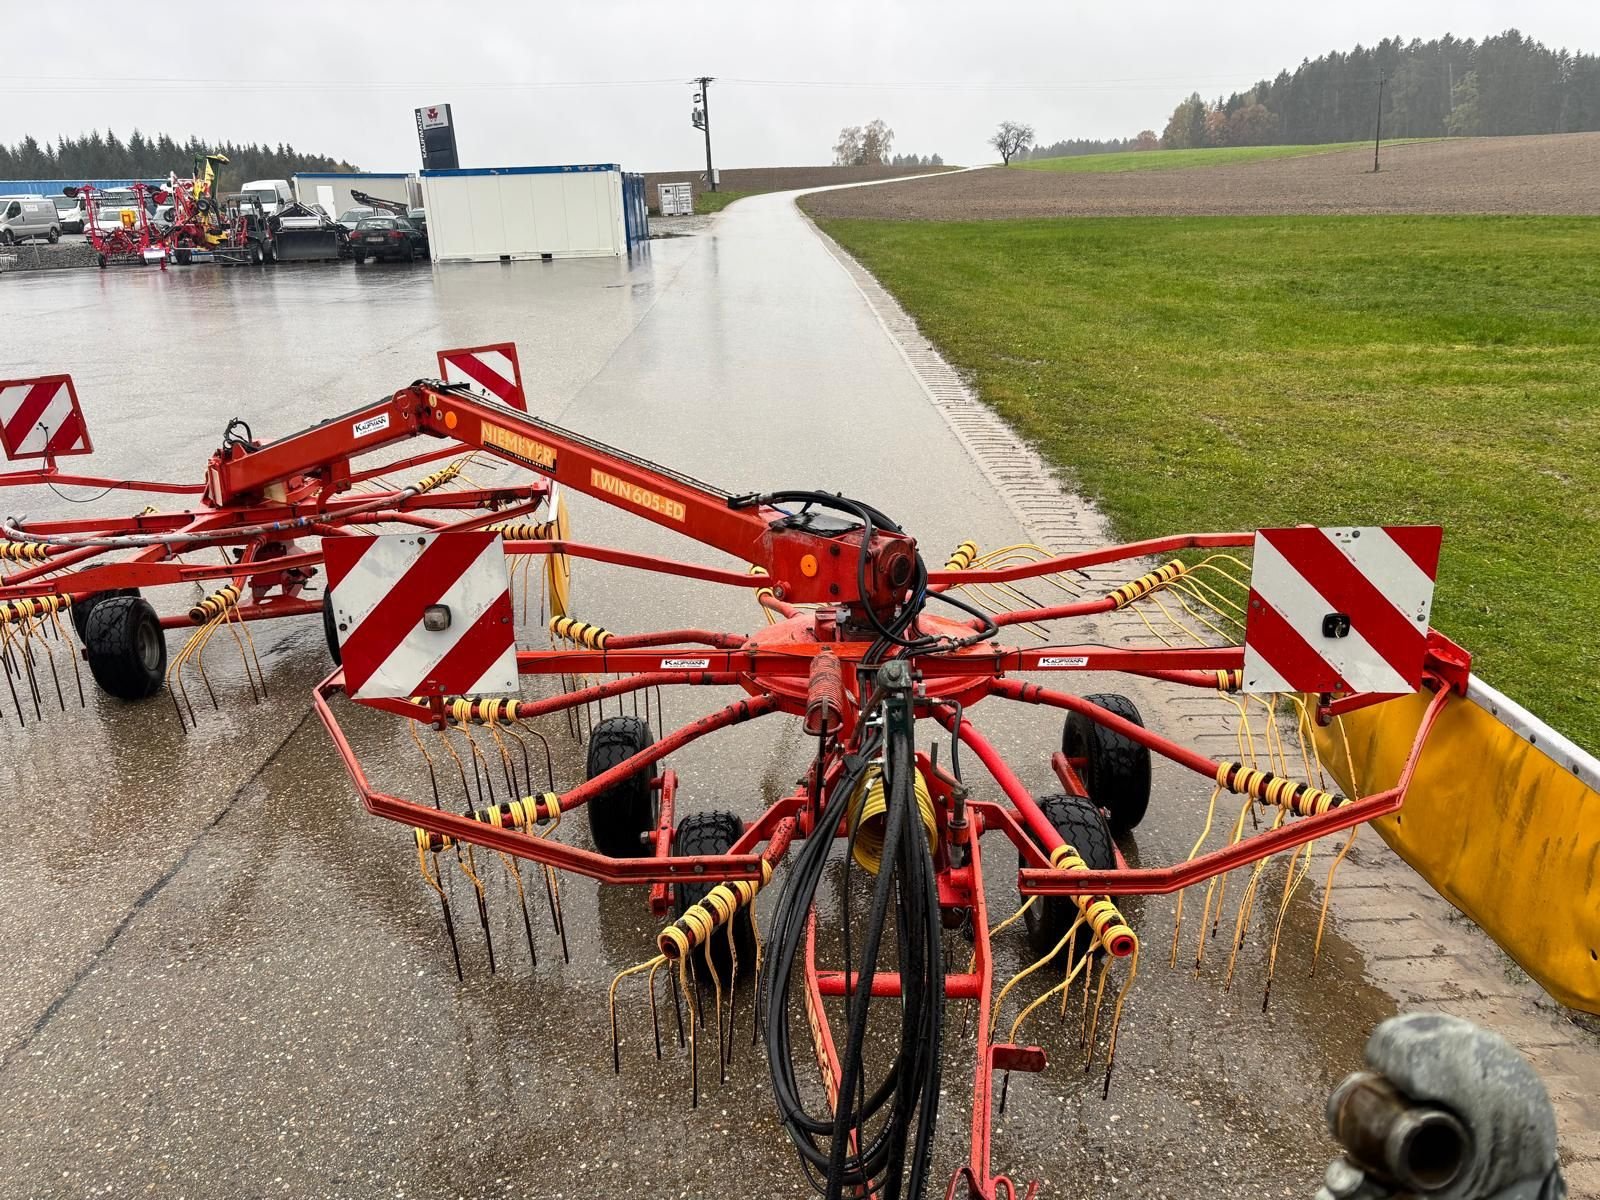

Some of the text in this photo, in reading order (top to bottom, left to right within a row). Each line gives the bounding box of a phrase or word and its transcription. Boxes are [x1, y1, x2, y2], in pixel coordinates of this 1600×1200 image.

[481, 421, 553, 465] NIEMEYER
[591, 470, 684, 520] TWIN 605-ED
